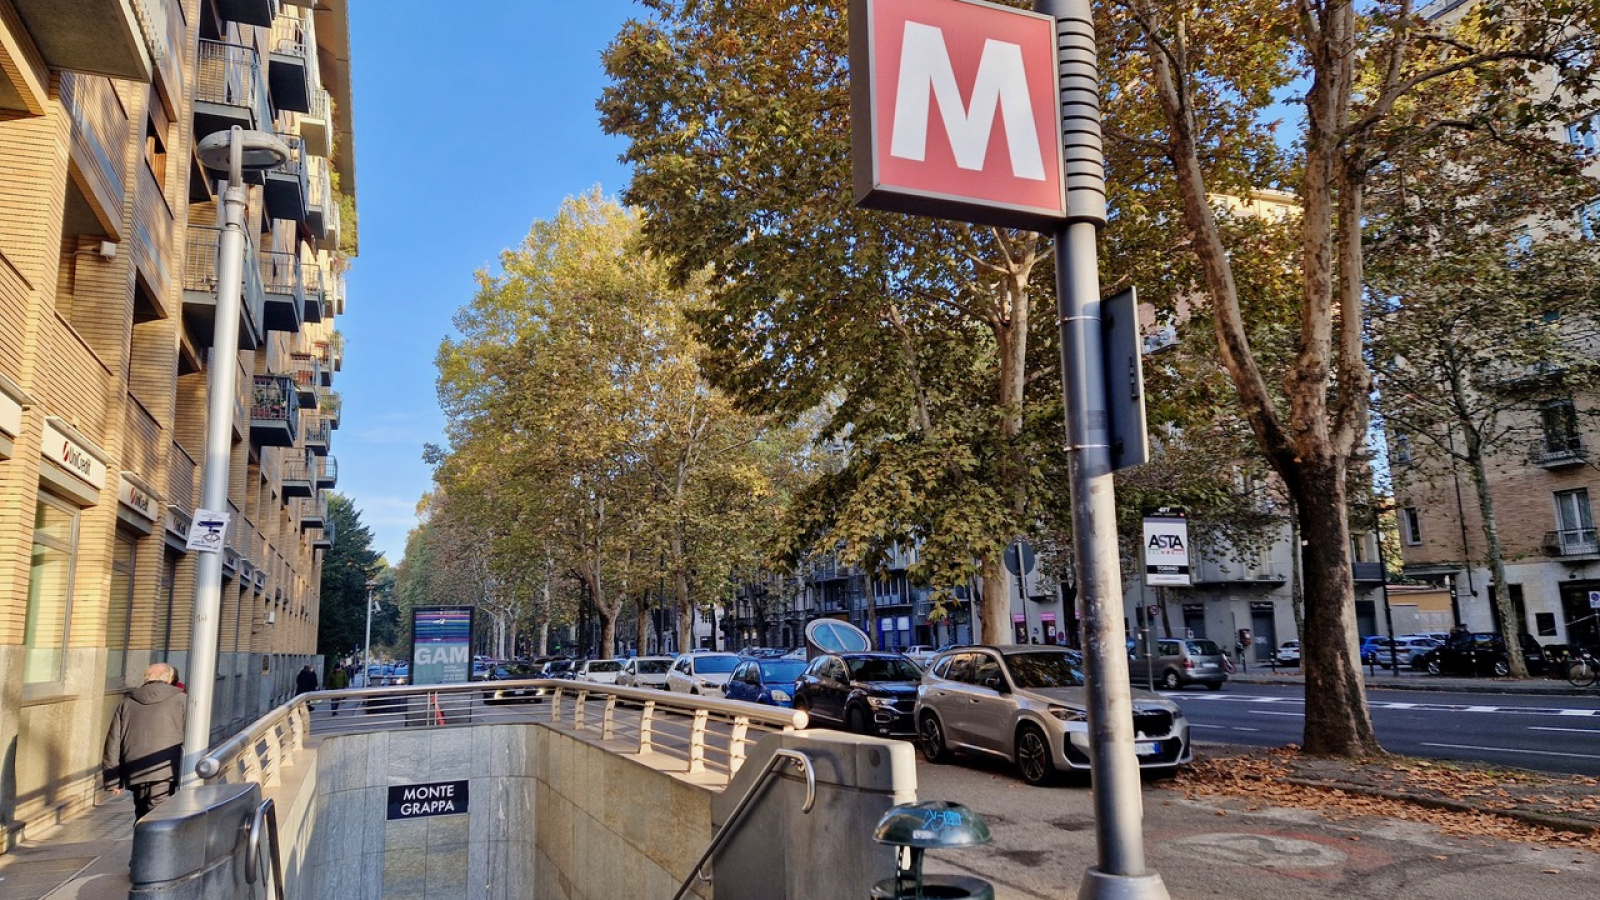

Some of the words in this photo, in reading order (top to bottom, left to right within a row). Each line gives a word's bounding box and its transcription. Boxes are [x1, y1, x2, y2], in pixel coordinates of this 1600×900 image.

[890, 20, 1046, 181] M
[69, 446, 91, 477] UniCredit
[1148, 534, 1184, 549] ASTA
[415, 646, 469, 666] GAM
[403, 784, 455, 801] MONTE
[400, 799, 455, 816] GRAPPA
